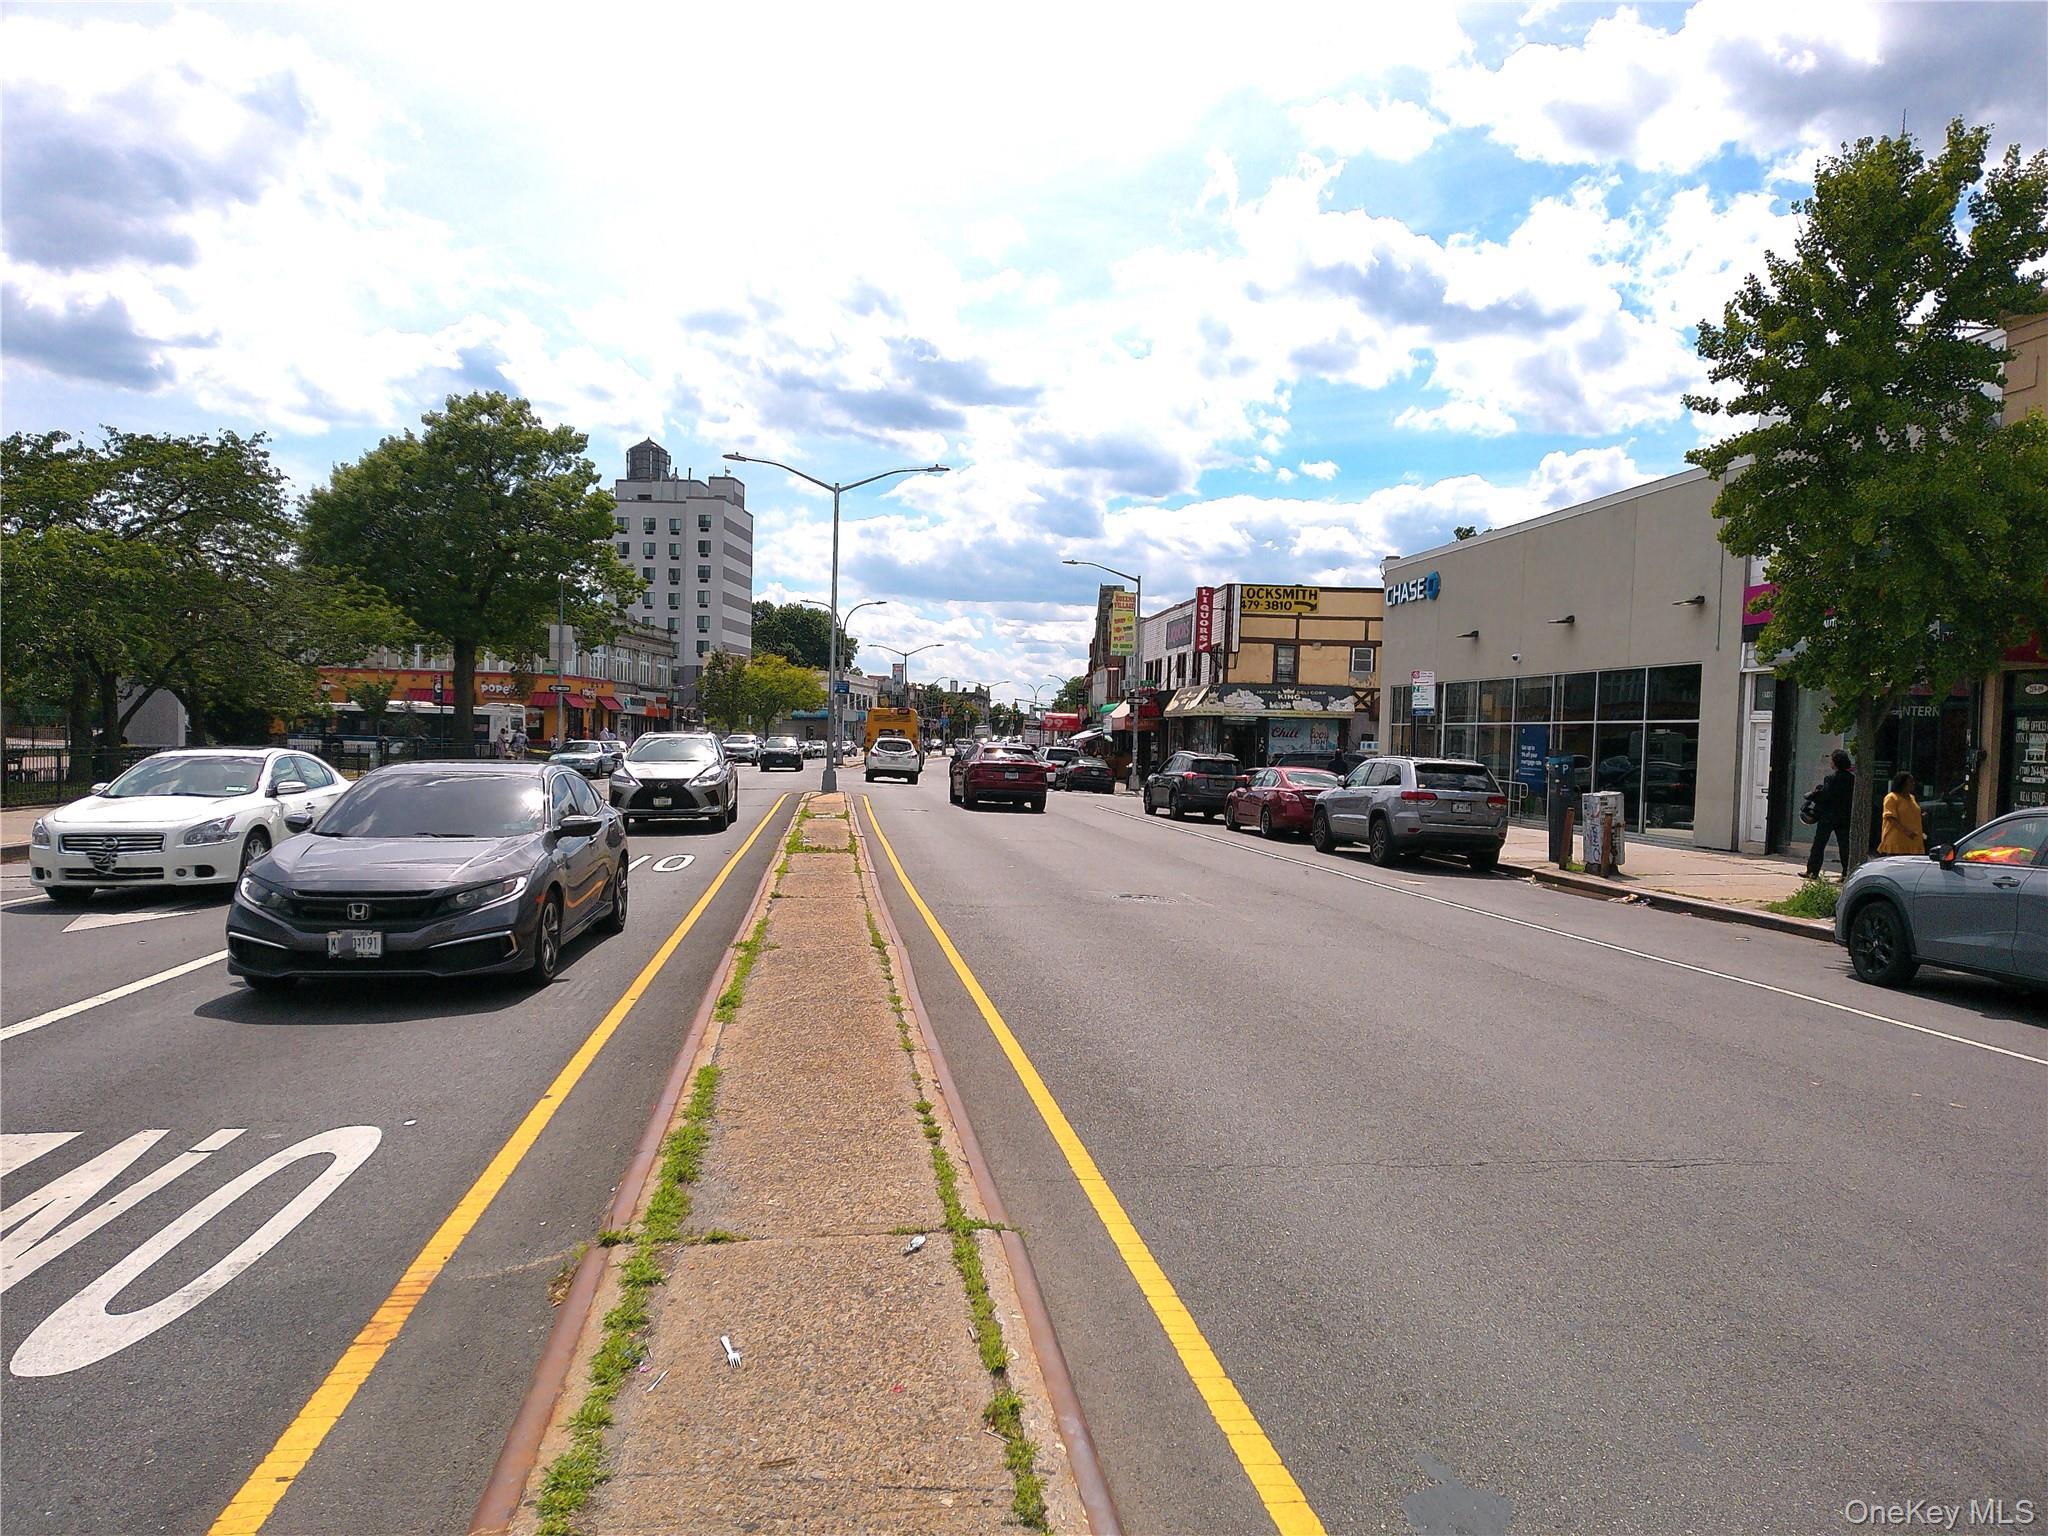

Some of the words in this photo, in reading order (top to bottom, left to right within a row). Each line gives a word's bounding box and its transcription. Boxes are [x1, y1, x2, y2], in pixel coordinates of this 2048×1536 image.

[1241, 587, 1318, 600] LOCKSMITH
[1386, 577, 1425, 606] CHASE
[1562, 764, 1569, 775] P
